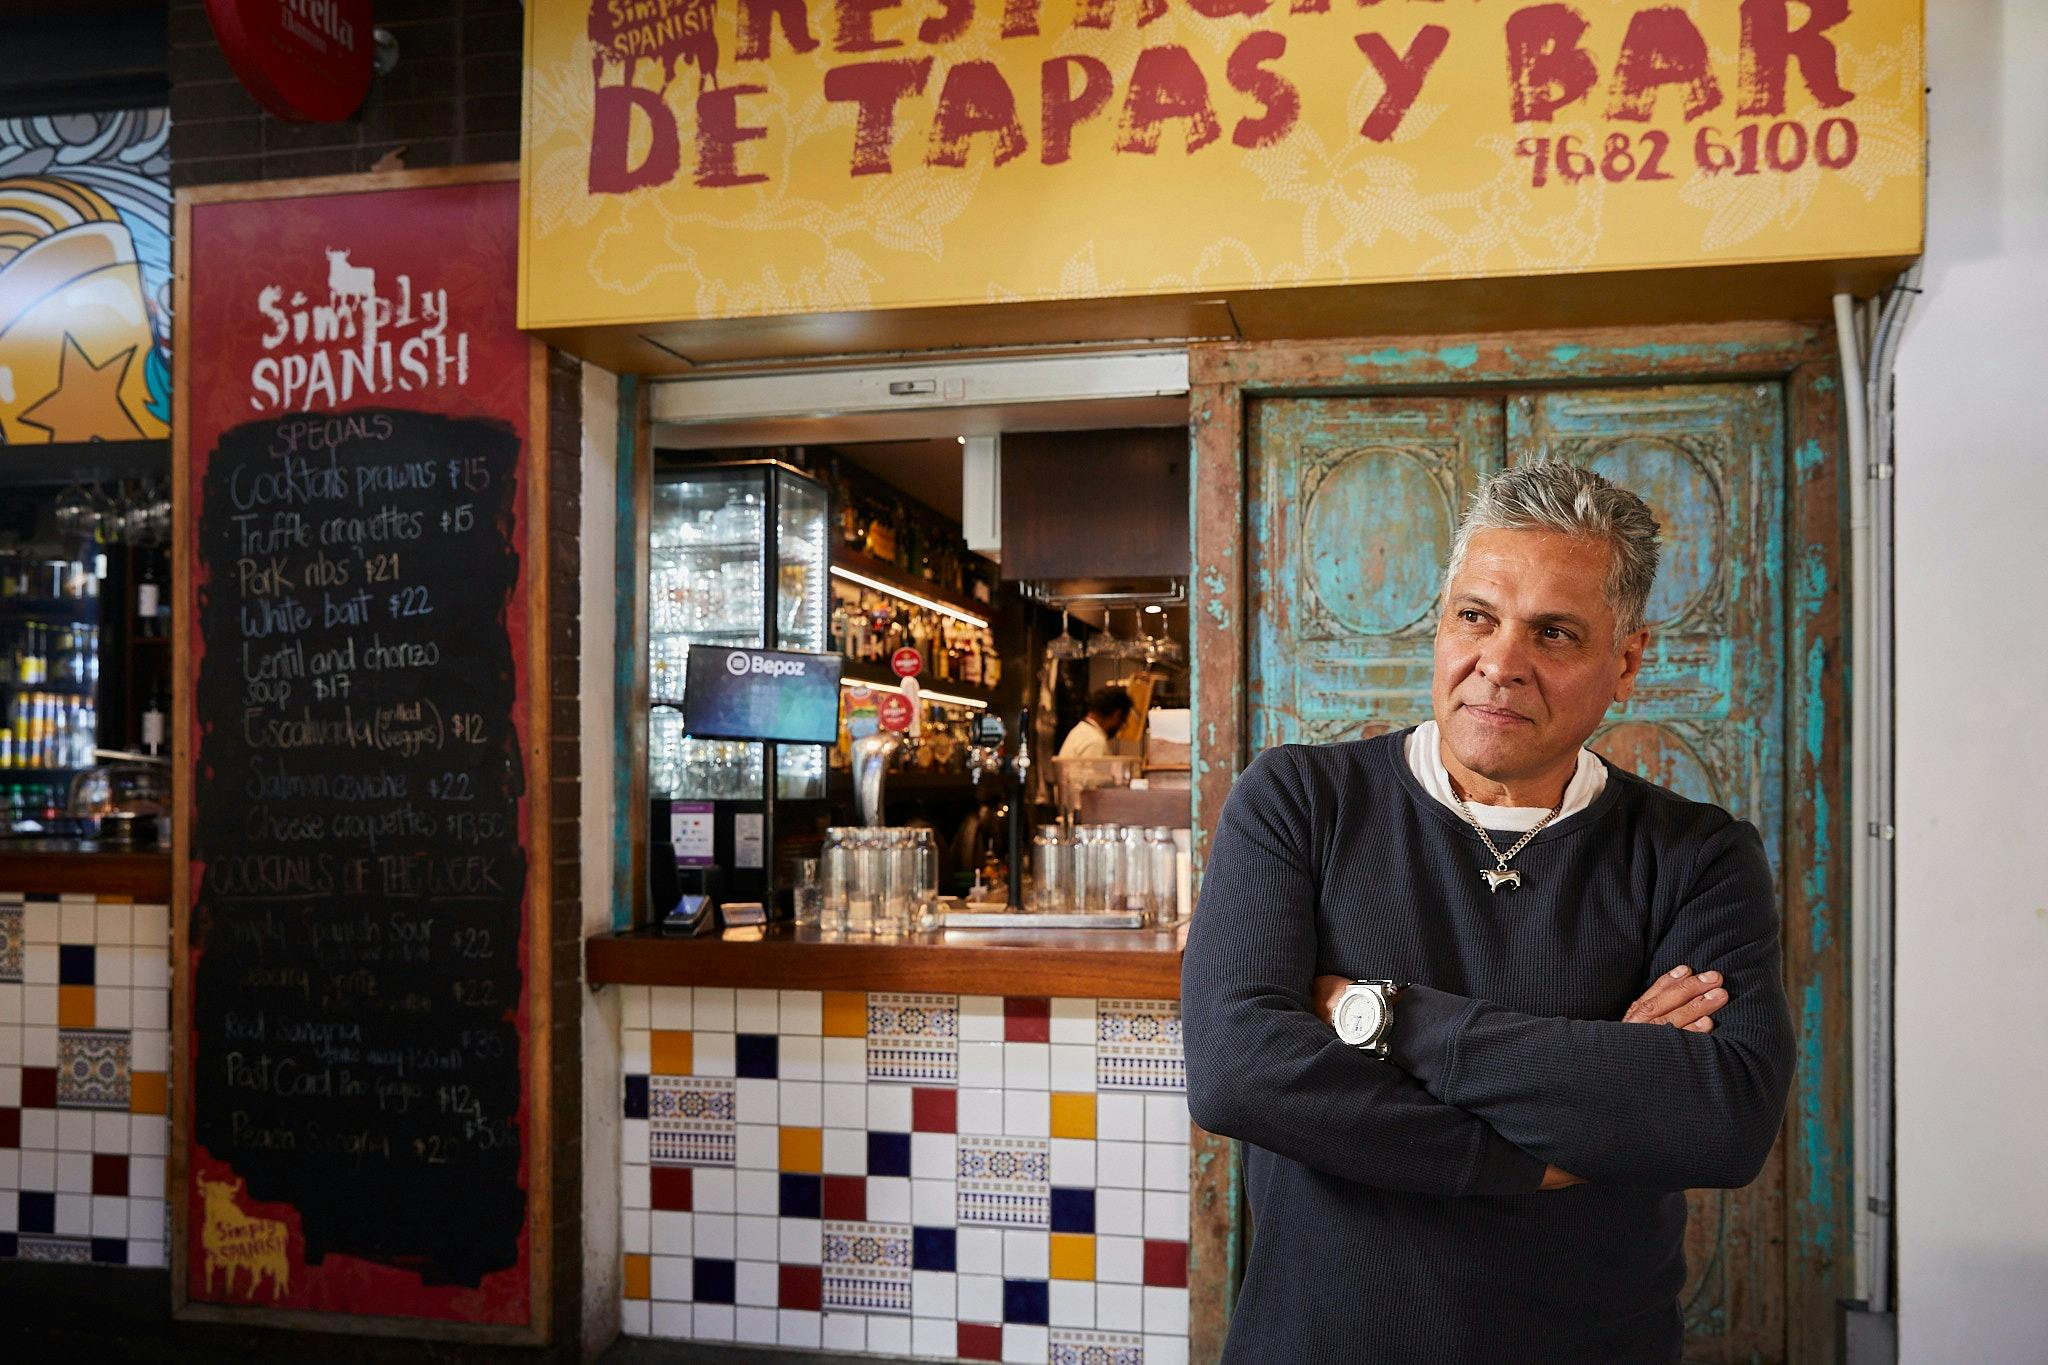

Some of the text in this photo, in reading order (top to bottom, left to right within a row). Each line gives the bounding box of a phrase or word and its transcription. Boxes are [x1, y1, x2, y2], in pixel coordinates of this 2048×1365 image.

[613, 4, 715, 55] SPANISH
[588, 84, 770, 195] DE
[823, 30, 1300, 178] TAPAS
[1354, 24, 1450, 142] Y
[1505, 0, 1856, 123] BAR
[1515, 118, 1857, 187] 9682 6100
[257, 274, 448, 350] Simply
[250, 332, 468, 411] SPANISH
[269, 413, 393, 456] SPECIALS
[237, 555, 295, 598] Pork
[241, 596, 312, 639] White
[388, 584, 434, 619] $22
[310, 638, 356, 674] and
[751, 655, 805, 677] Bepoz
